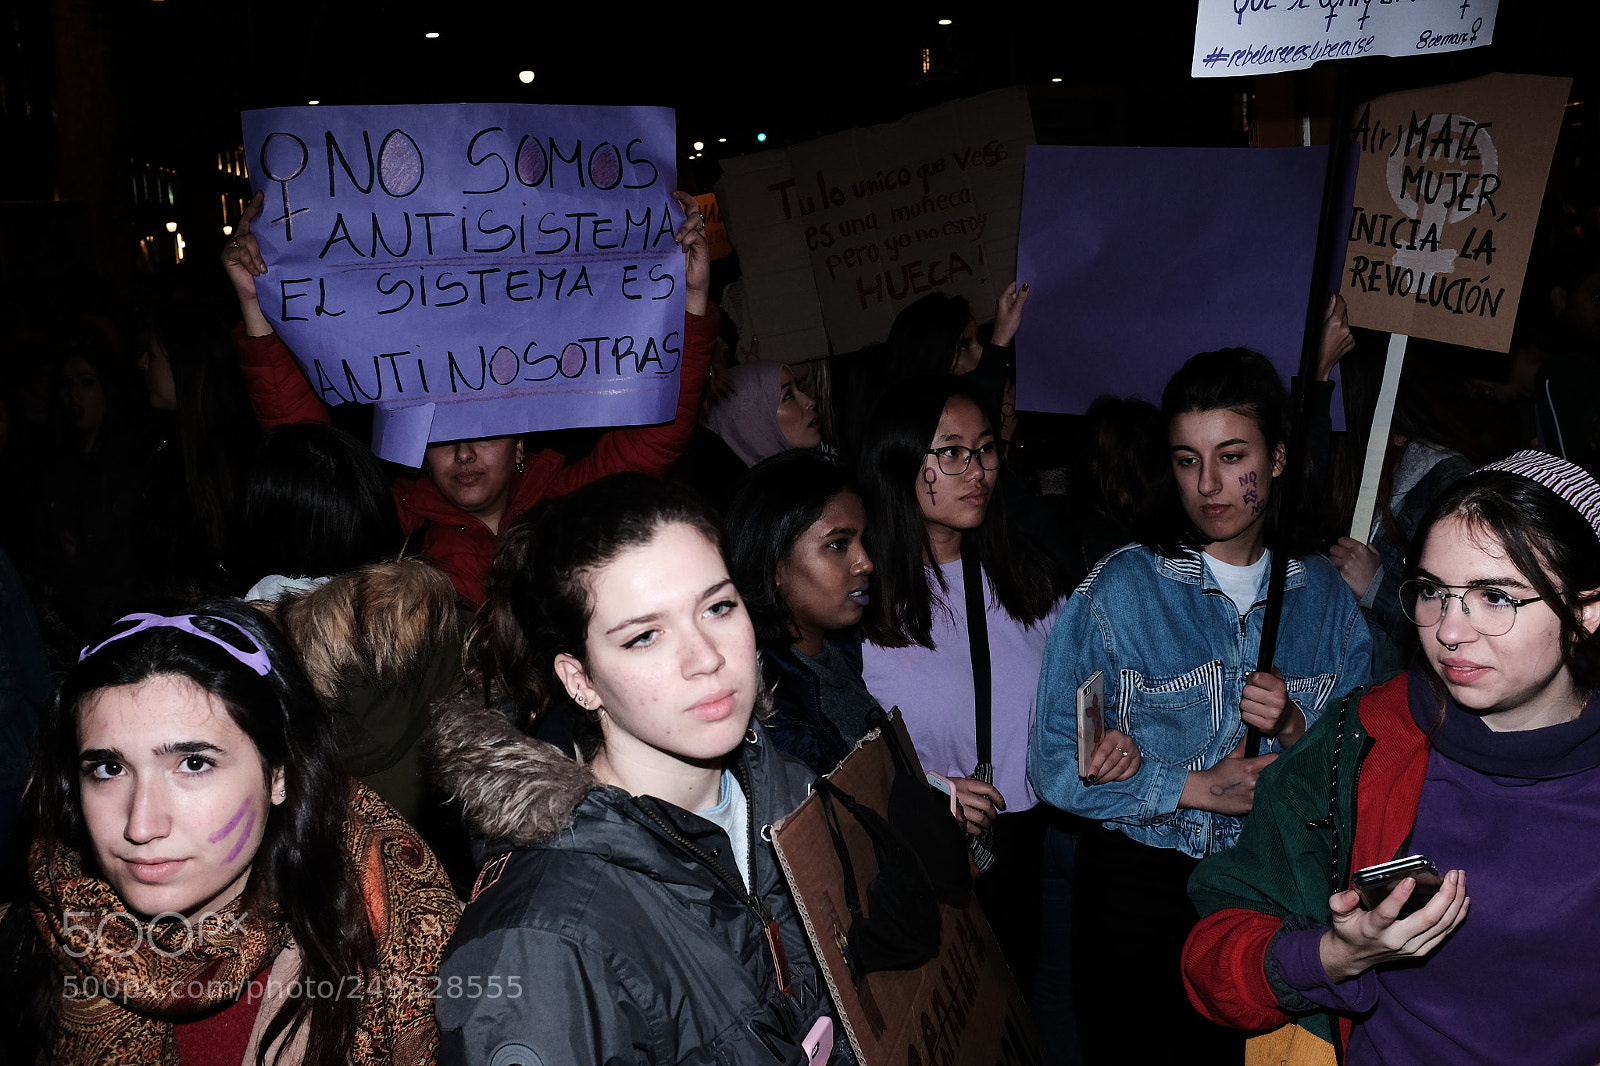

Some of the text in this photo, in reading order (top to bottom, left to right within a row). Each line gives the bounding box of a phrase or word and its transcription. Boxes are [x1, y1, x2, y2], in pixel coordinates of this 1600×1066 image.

[325, 127, 659, 197] NO SOMOS
[768, 178, 815, 219] Tu
[816, 170, 846, 209] lo
[1400, 165, 1507, 222] MUJER,
[839, 212, 879, 238] una
[915, 226, 940, 243] no
[1348, 206, 1496, 265] INICIA LA
[281, 277, 346, 321] EL
[621, 263, 676, 301] ES
[1349, 255, 1506, 317] REVOLUCIÓN
